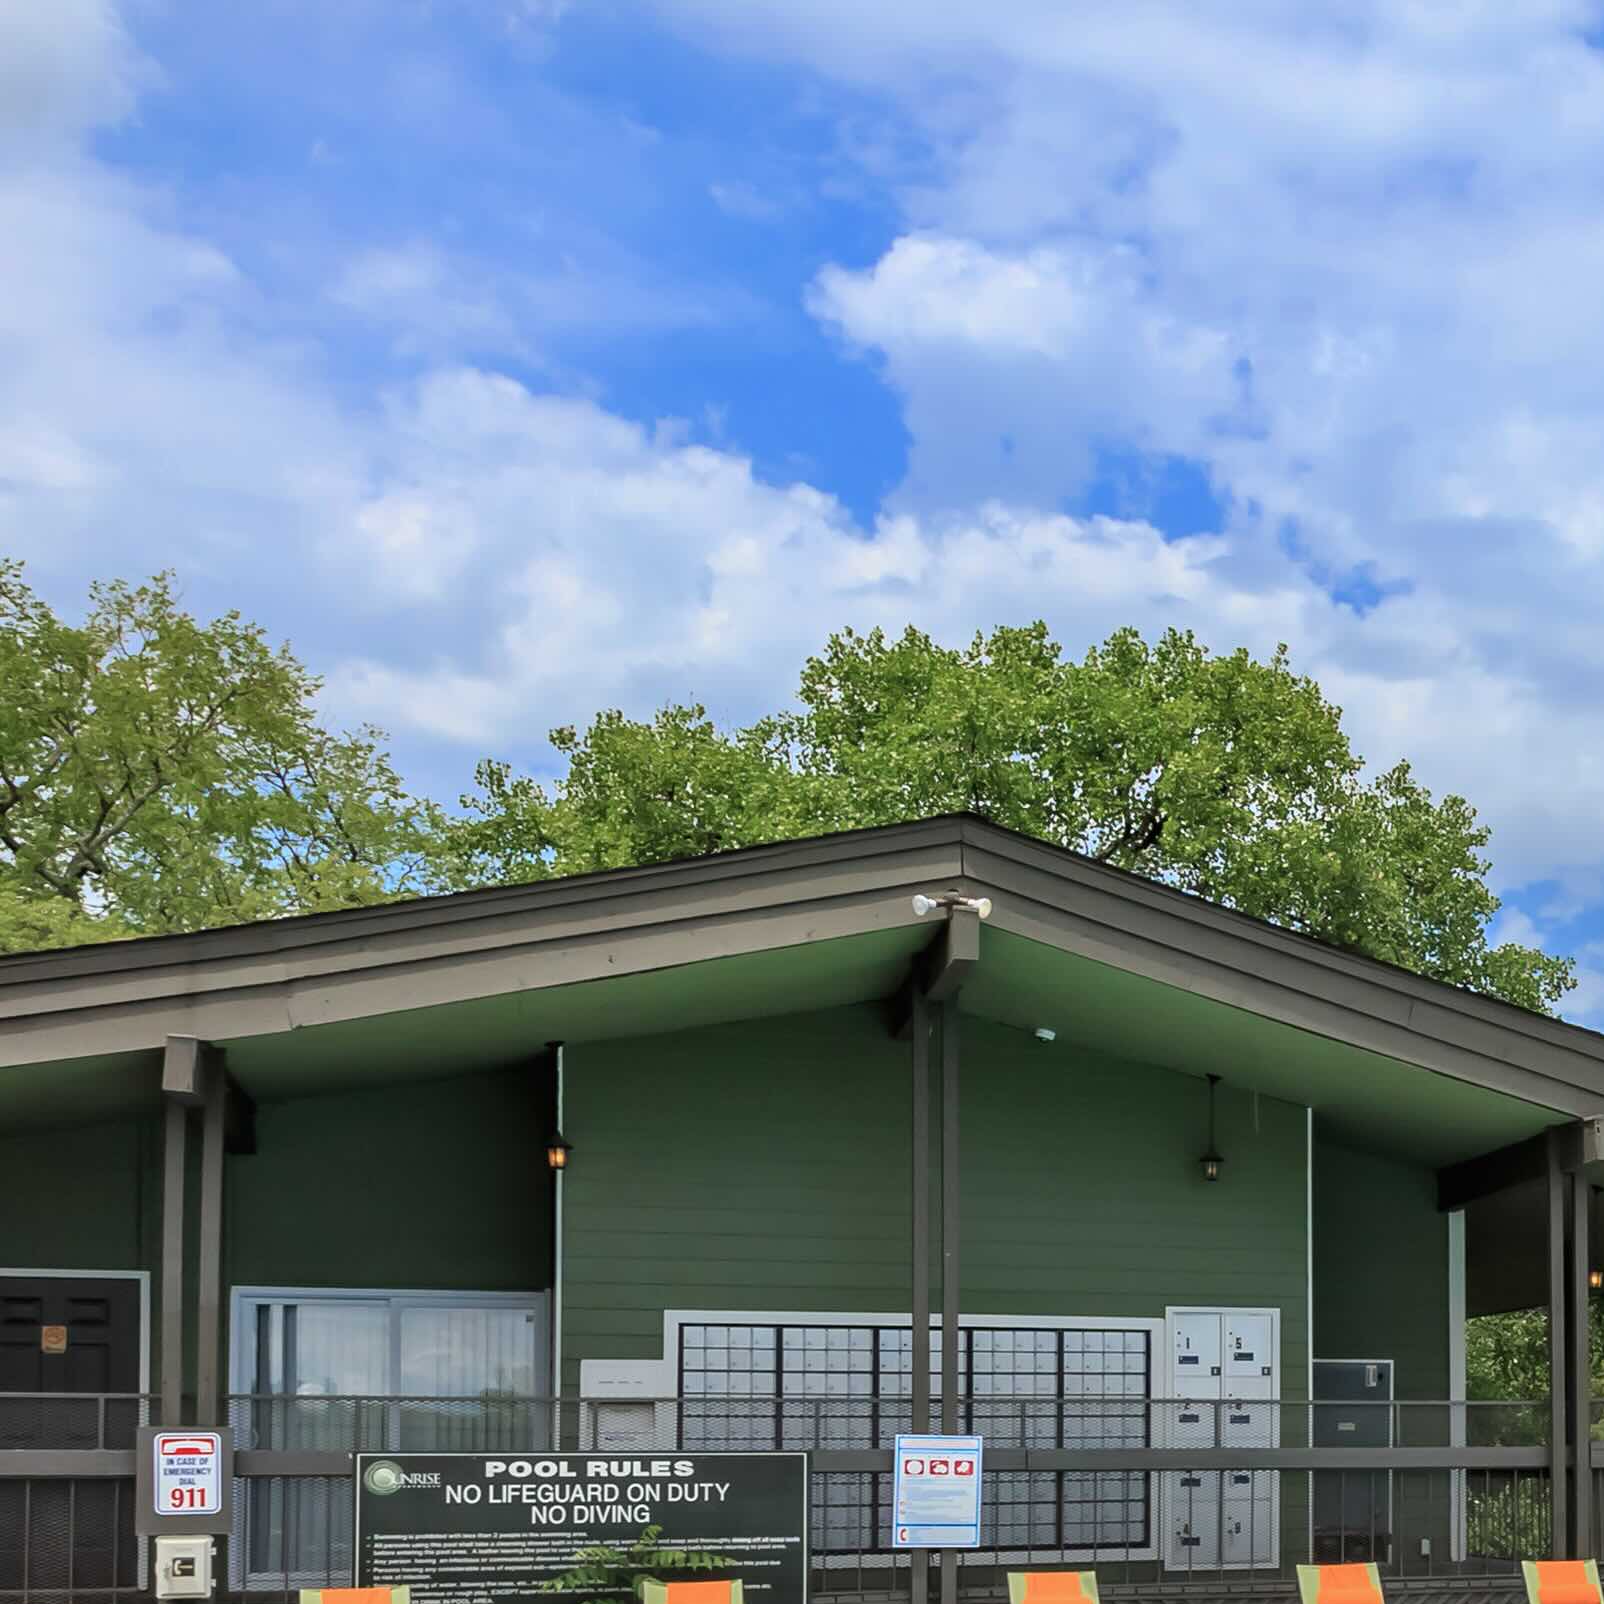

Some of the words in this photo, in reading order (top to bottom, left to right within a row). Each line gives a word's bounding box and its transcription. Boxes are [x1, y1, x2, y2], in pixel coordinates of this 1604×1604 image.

[1235, 1337, 1242, 1349] 5
[163, 1468, 211, 1476] EMERGENCY
[485, 1461, 577, 1478] POOL
[587, 1461, 695, 1477] RULES
[171, 1488, 206, 1508] 911
[445, 1484, 482, 1504] NO
[488, 1483, 620, 1503] LIFEGUARD
[626, 1483, 660, 1502] ON
[668, 1482, 731, 1502] DUTY
[531, 1505, 567, 1524] NO
[573, 1504, 651, 1524] DIVING
